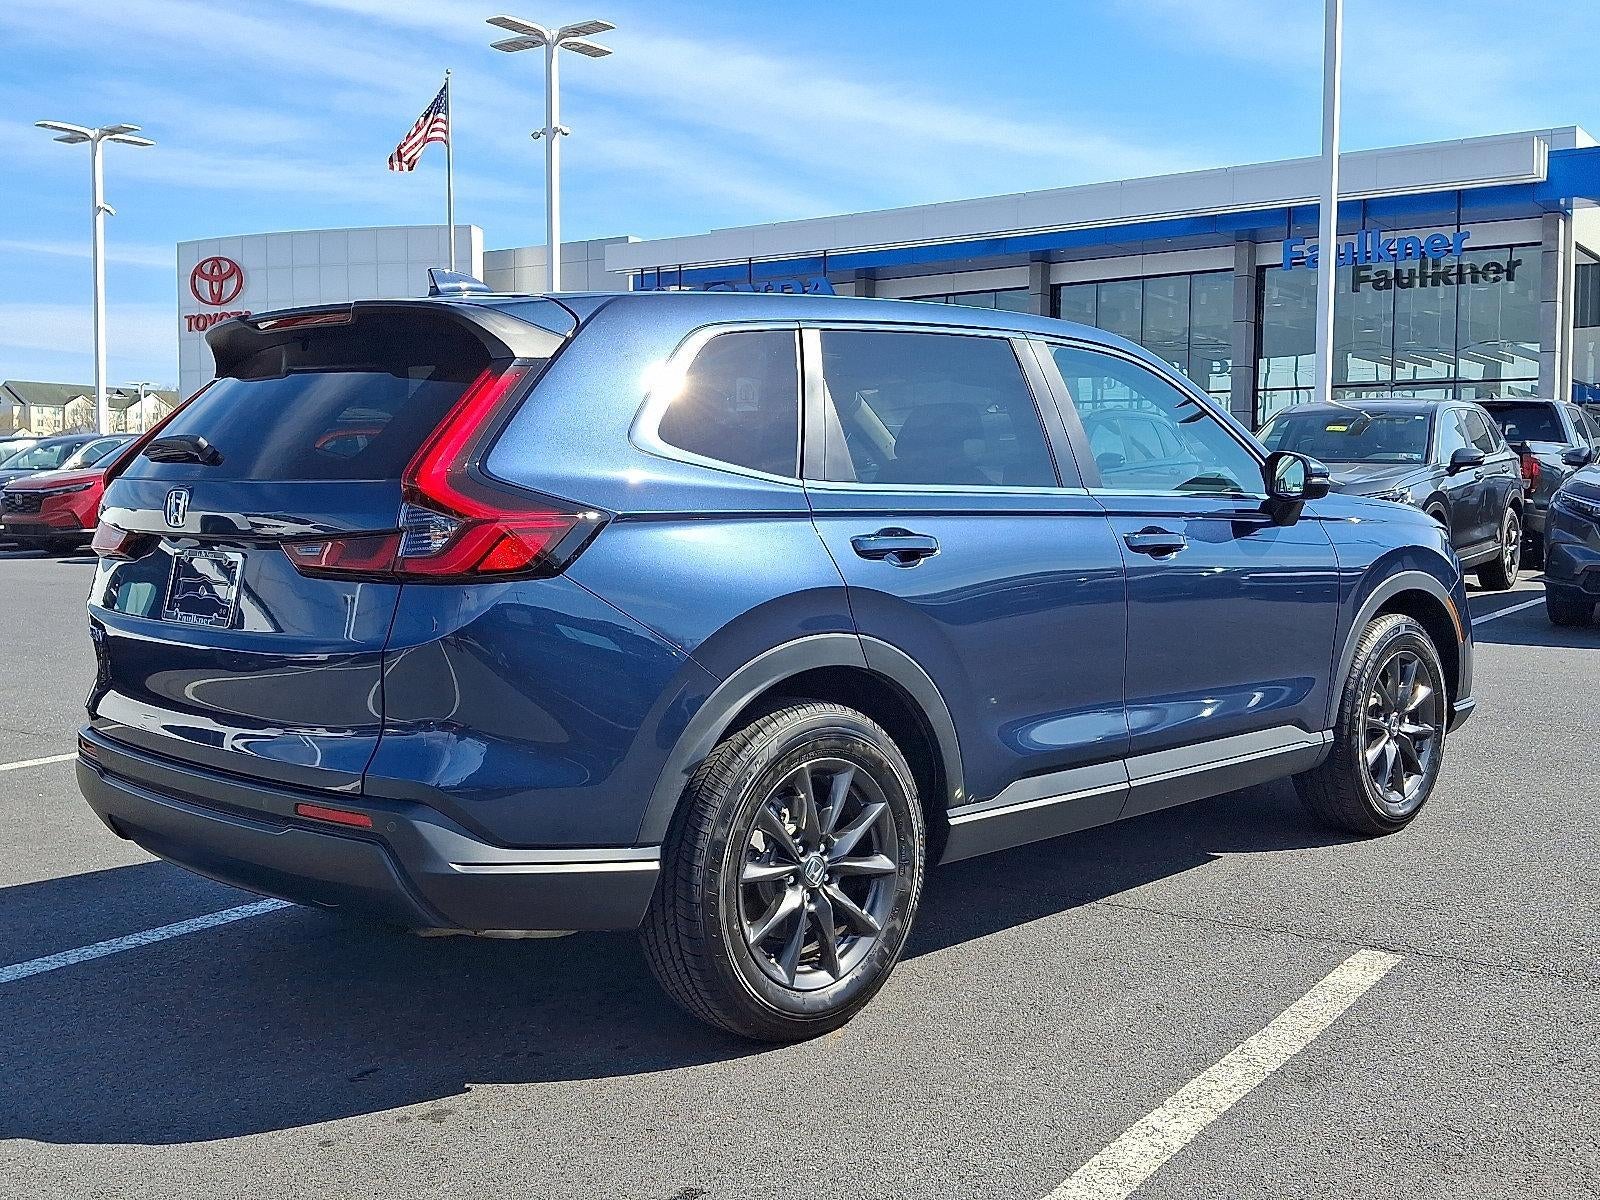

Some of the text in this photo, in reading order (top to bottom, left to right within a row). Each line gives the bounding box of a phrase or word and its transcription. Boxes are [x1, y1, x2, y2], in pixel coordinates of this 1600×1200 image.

[1283, 229, 1470, 271] Faulkner
[1352, 258, 1522, 293] Faulkner
[184, 311, 251, 332] TOY
[177, 612, 214, 625] Faulkner
